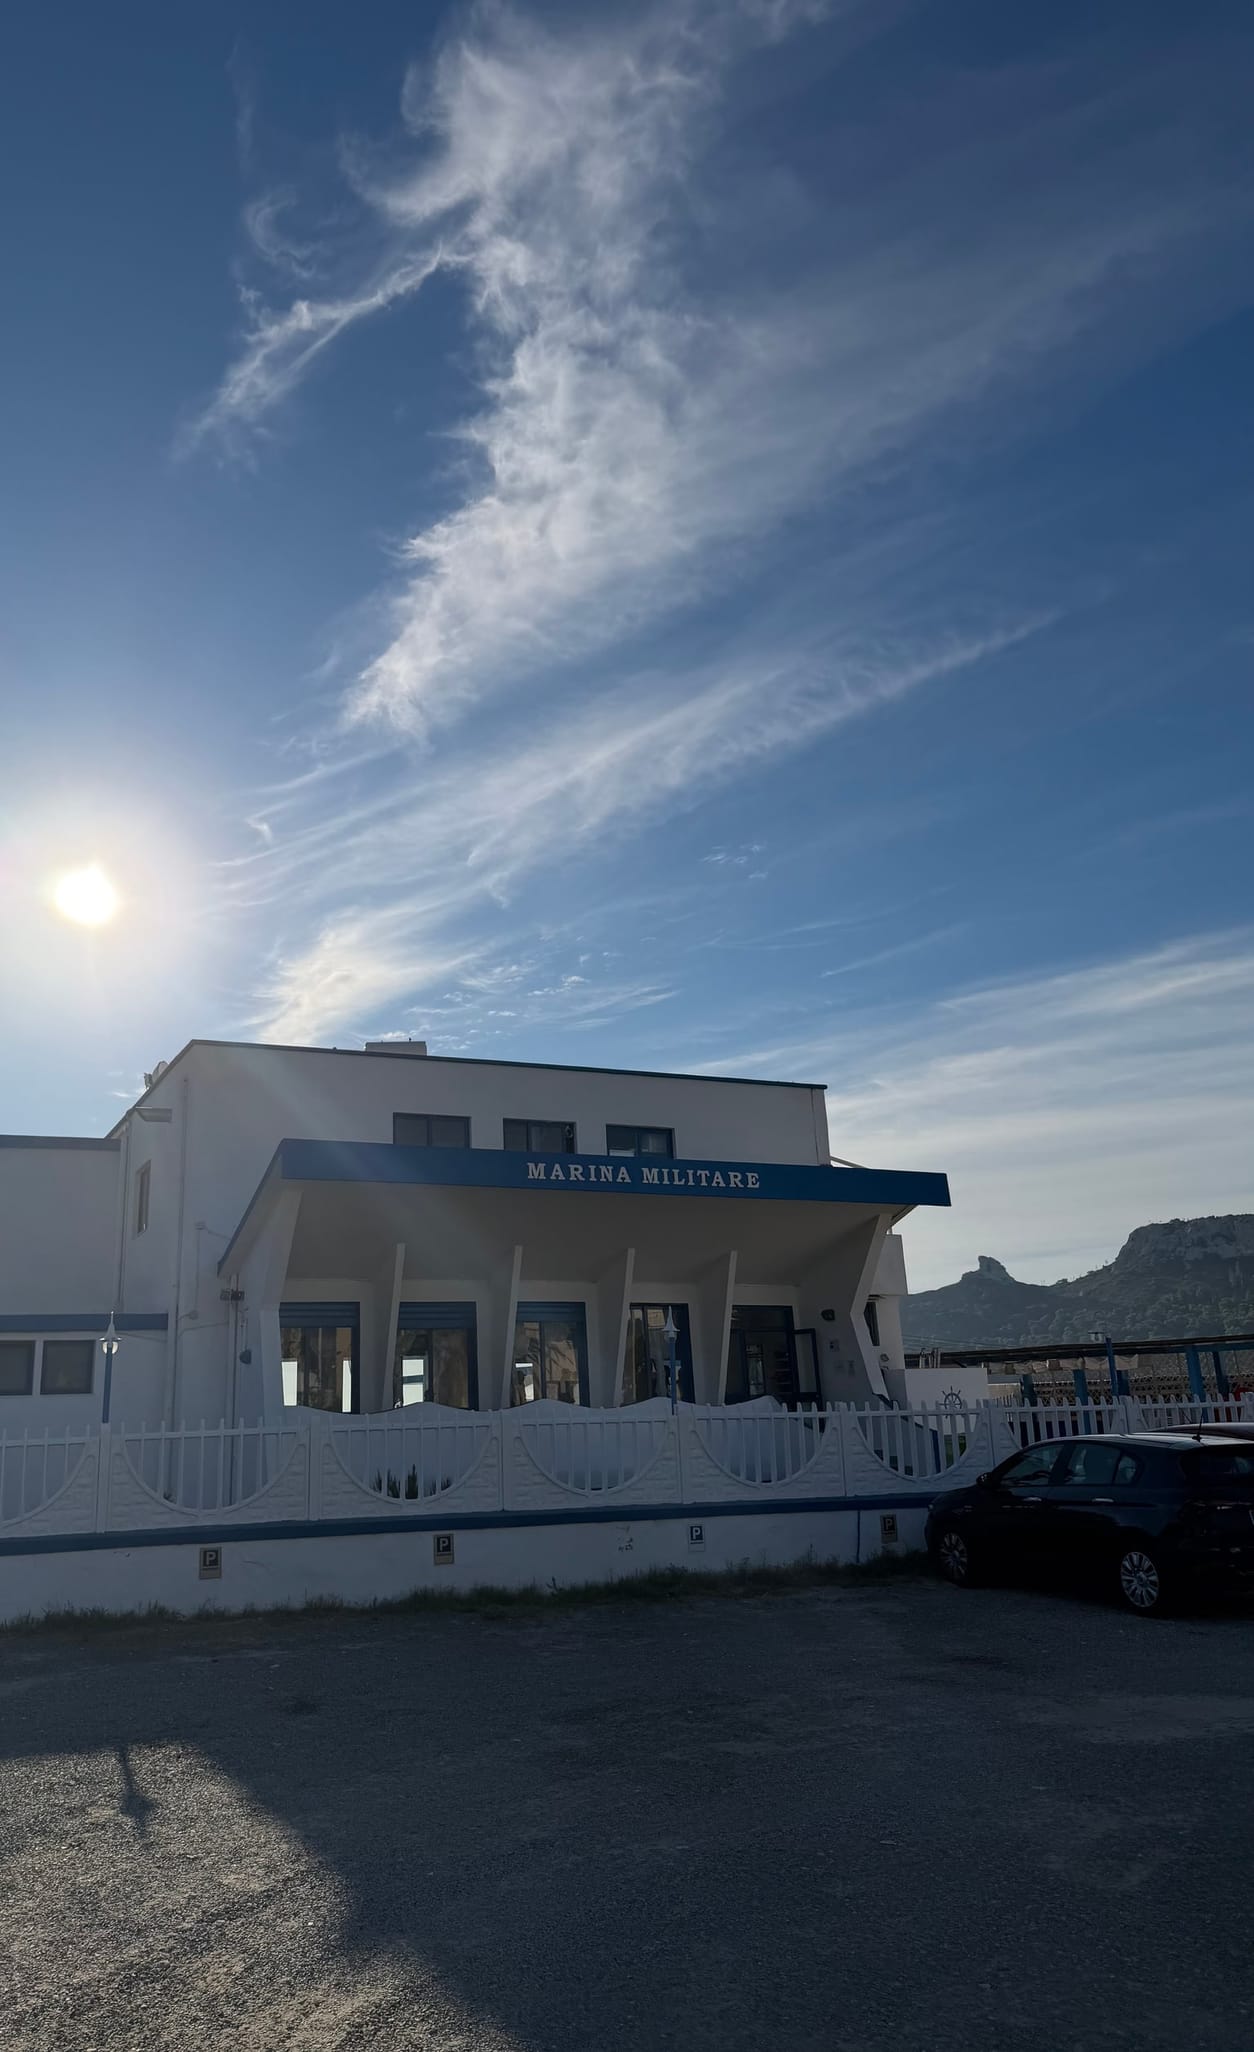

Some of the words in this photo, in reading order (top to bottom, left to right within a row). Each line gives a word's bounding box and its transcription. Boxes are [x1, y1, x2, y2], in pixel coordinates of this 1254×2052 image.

[527, 1162, 632, 1183] MARINA
[641, 1167, 760, 1188] MILITARE
[885, 1518, 893, 1530] P
[692, 1527, 701, 1540] P
[440, 1538, 449, 1551] P
[206, 1551, 216, 1566] P
